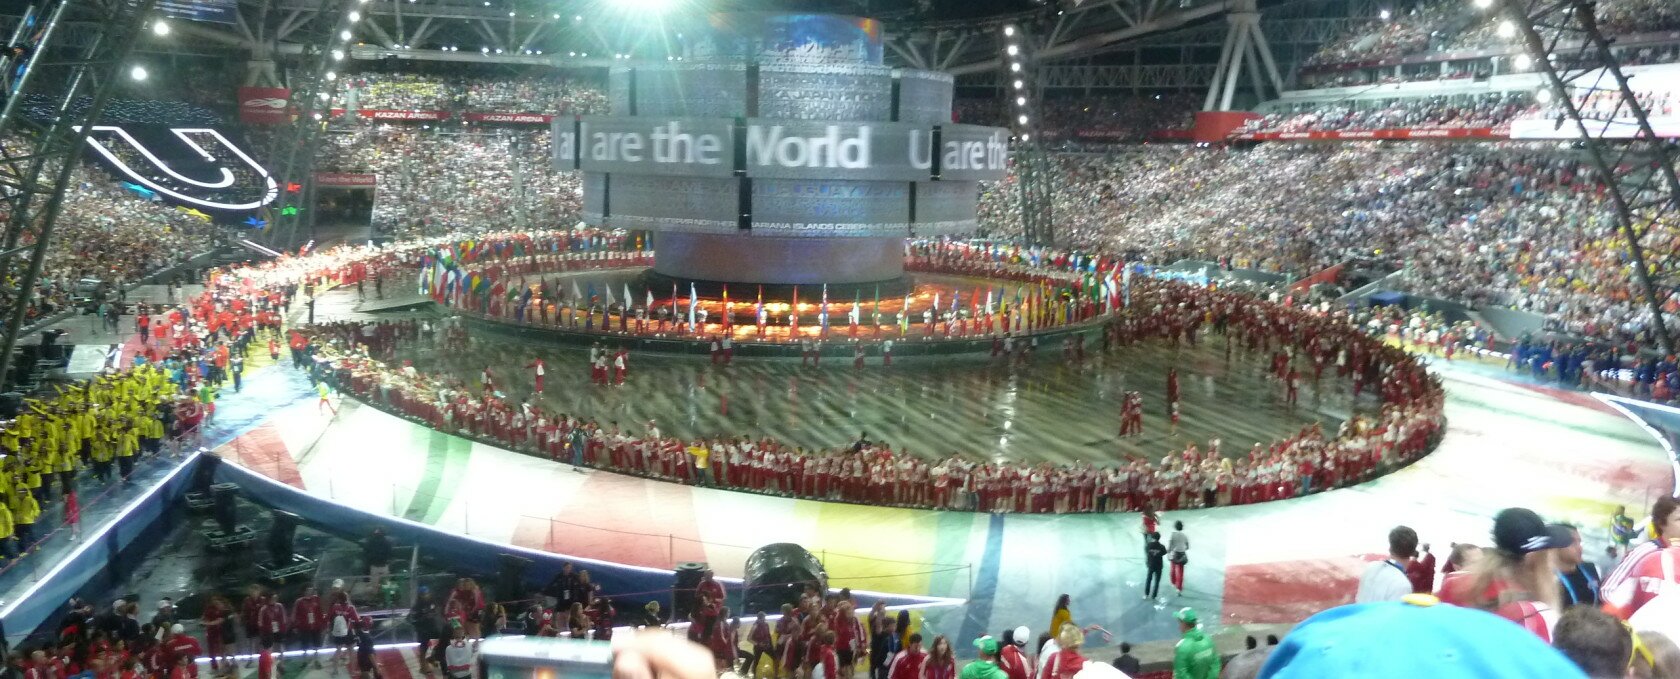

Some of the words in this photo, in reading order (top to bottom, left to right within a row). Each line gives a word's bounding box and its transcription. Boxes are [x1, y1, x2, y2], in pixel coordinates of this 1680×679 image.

[374, 111, 407, 119] KAZAN
[408, 112, 438, 120] ARENA
[514, 115, 544, 123] ARENA
[591, 131, 643, 162] are
[651, 121, 722, 165] the
[727, 124, 872, 169] World
[943, 139, 985, 170] are
